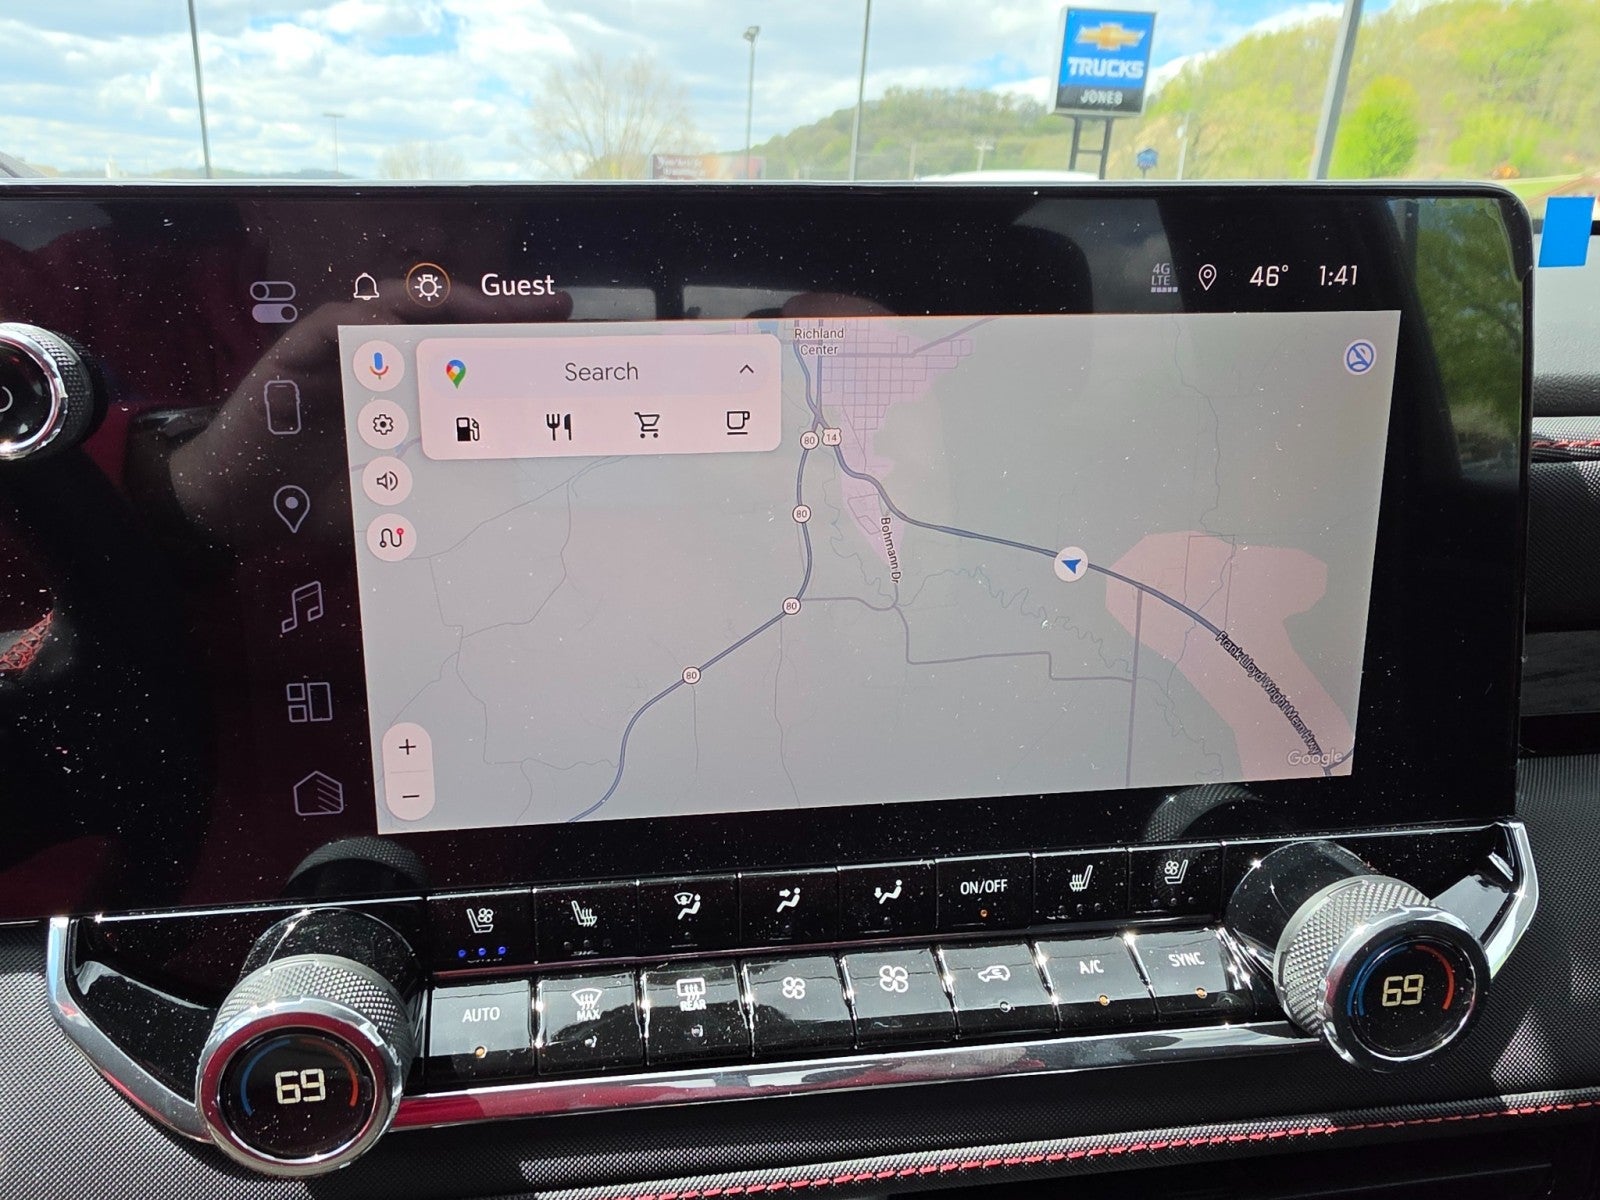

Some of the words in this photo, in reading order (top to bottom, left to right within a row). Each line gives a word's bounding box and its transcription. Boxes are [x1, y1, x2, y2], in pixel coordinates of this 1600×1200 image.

[1067, 56, 1145, 79] TRUCKS
[1080, 89, 1123, 106] JONES
[1152, 263, 1170, 275] 4G
[1250, 264, 1289, 287] 46°
[1319, 265, 1359, 286] 1:41
[480, 273, 556, 296] Guest
[1151, 275, 1171, 286] LTE
[794, 328, 844, 340] Richland
[800, 344, 838, 356] Center
[564, 361, 639, 382] Search
[803, 435, 816, 445] 80
[826, 433, 837, 443] 14
[796, 509, 808, 519] 80
[881, 517, 899, 570] Bohmann
[891, 571, 902, 584] Dr
[786, 601, 798, 611] 80
[686, 670, 698, 680] 80
[1215, 631, 1244, 661] Frank
[1239, 654, 1267, 683] Lloyd
[1261, 676, 1290, 712] Wright
[1284, 705, 1309, 734] Mem
[1301, 729, 1322, 756] Hwy
[1287, 748, 1343, 767] Google
[960, 878, 1008, 895] ON/OFF
[1079, 959, 1105, 975] A/C
[1168, 952, 1205, 968] SYNC
[1382, 974, 1424, 1007] 69
[680, 1000, 707, 1012] REAR
[462, 1006, 501, 1023] AUTO
[576, 1008, 600, 1021] MAX
[275, 1068, 326, 1104] 69
